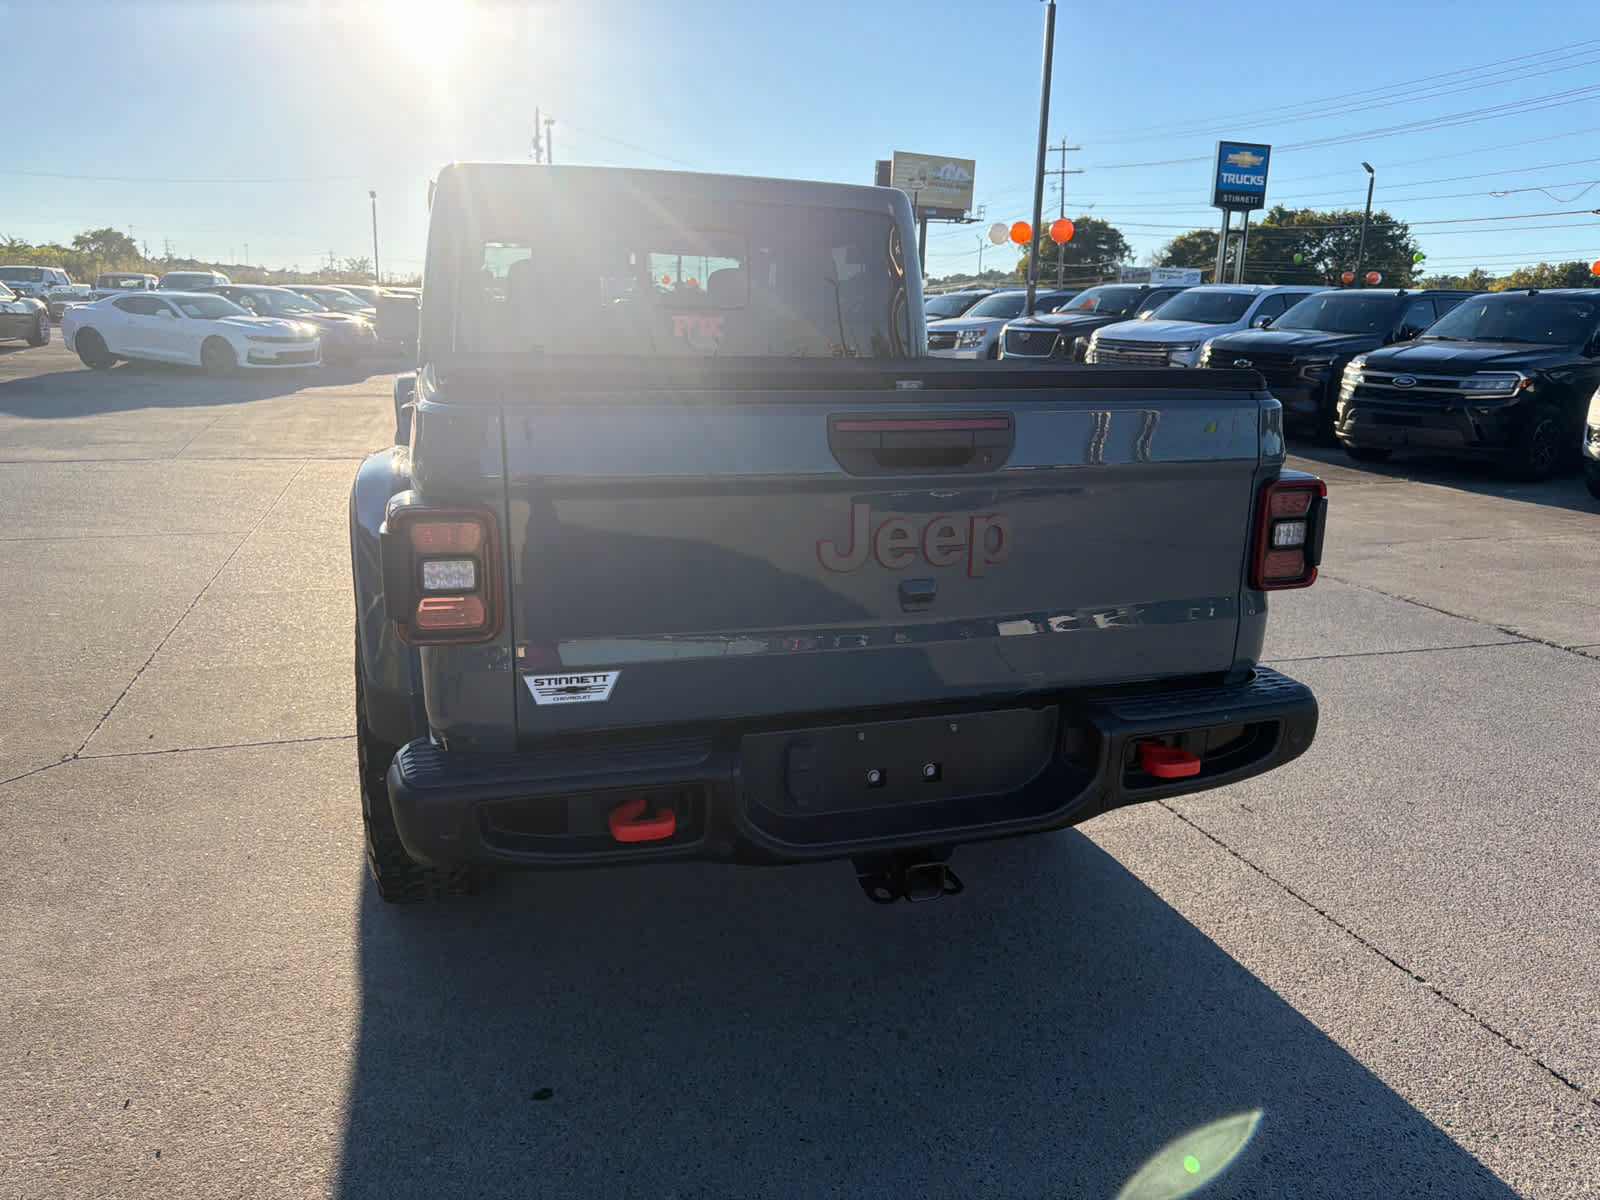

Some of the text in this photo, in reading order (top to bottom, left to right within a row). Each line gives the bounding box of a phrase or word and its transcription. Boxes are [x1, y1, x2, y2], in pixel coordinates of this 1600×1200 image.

[1221, 173, 1264, 186] TRUCKS
[1223, 194, 1259, 204] STINNETT
[816, 502, 1010, 579] Jeep
[534, 674, 610, 687] STINNETT
